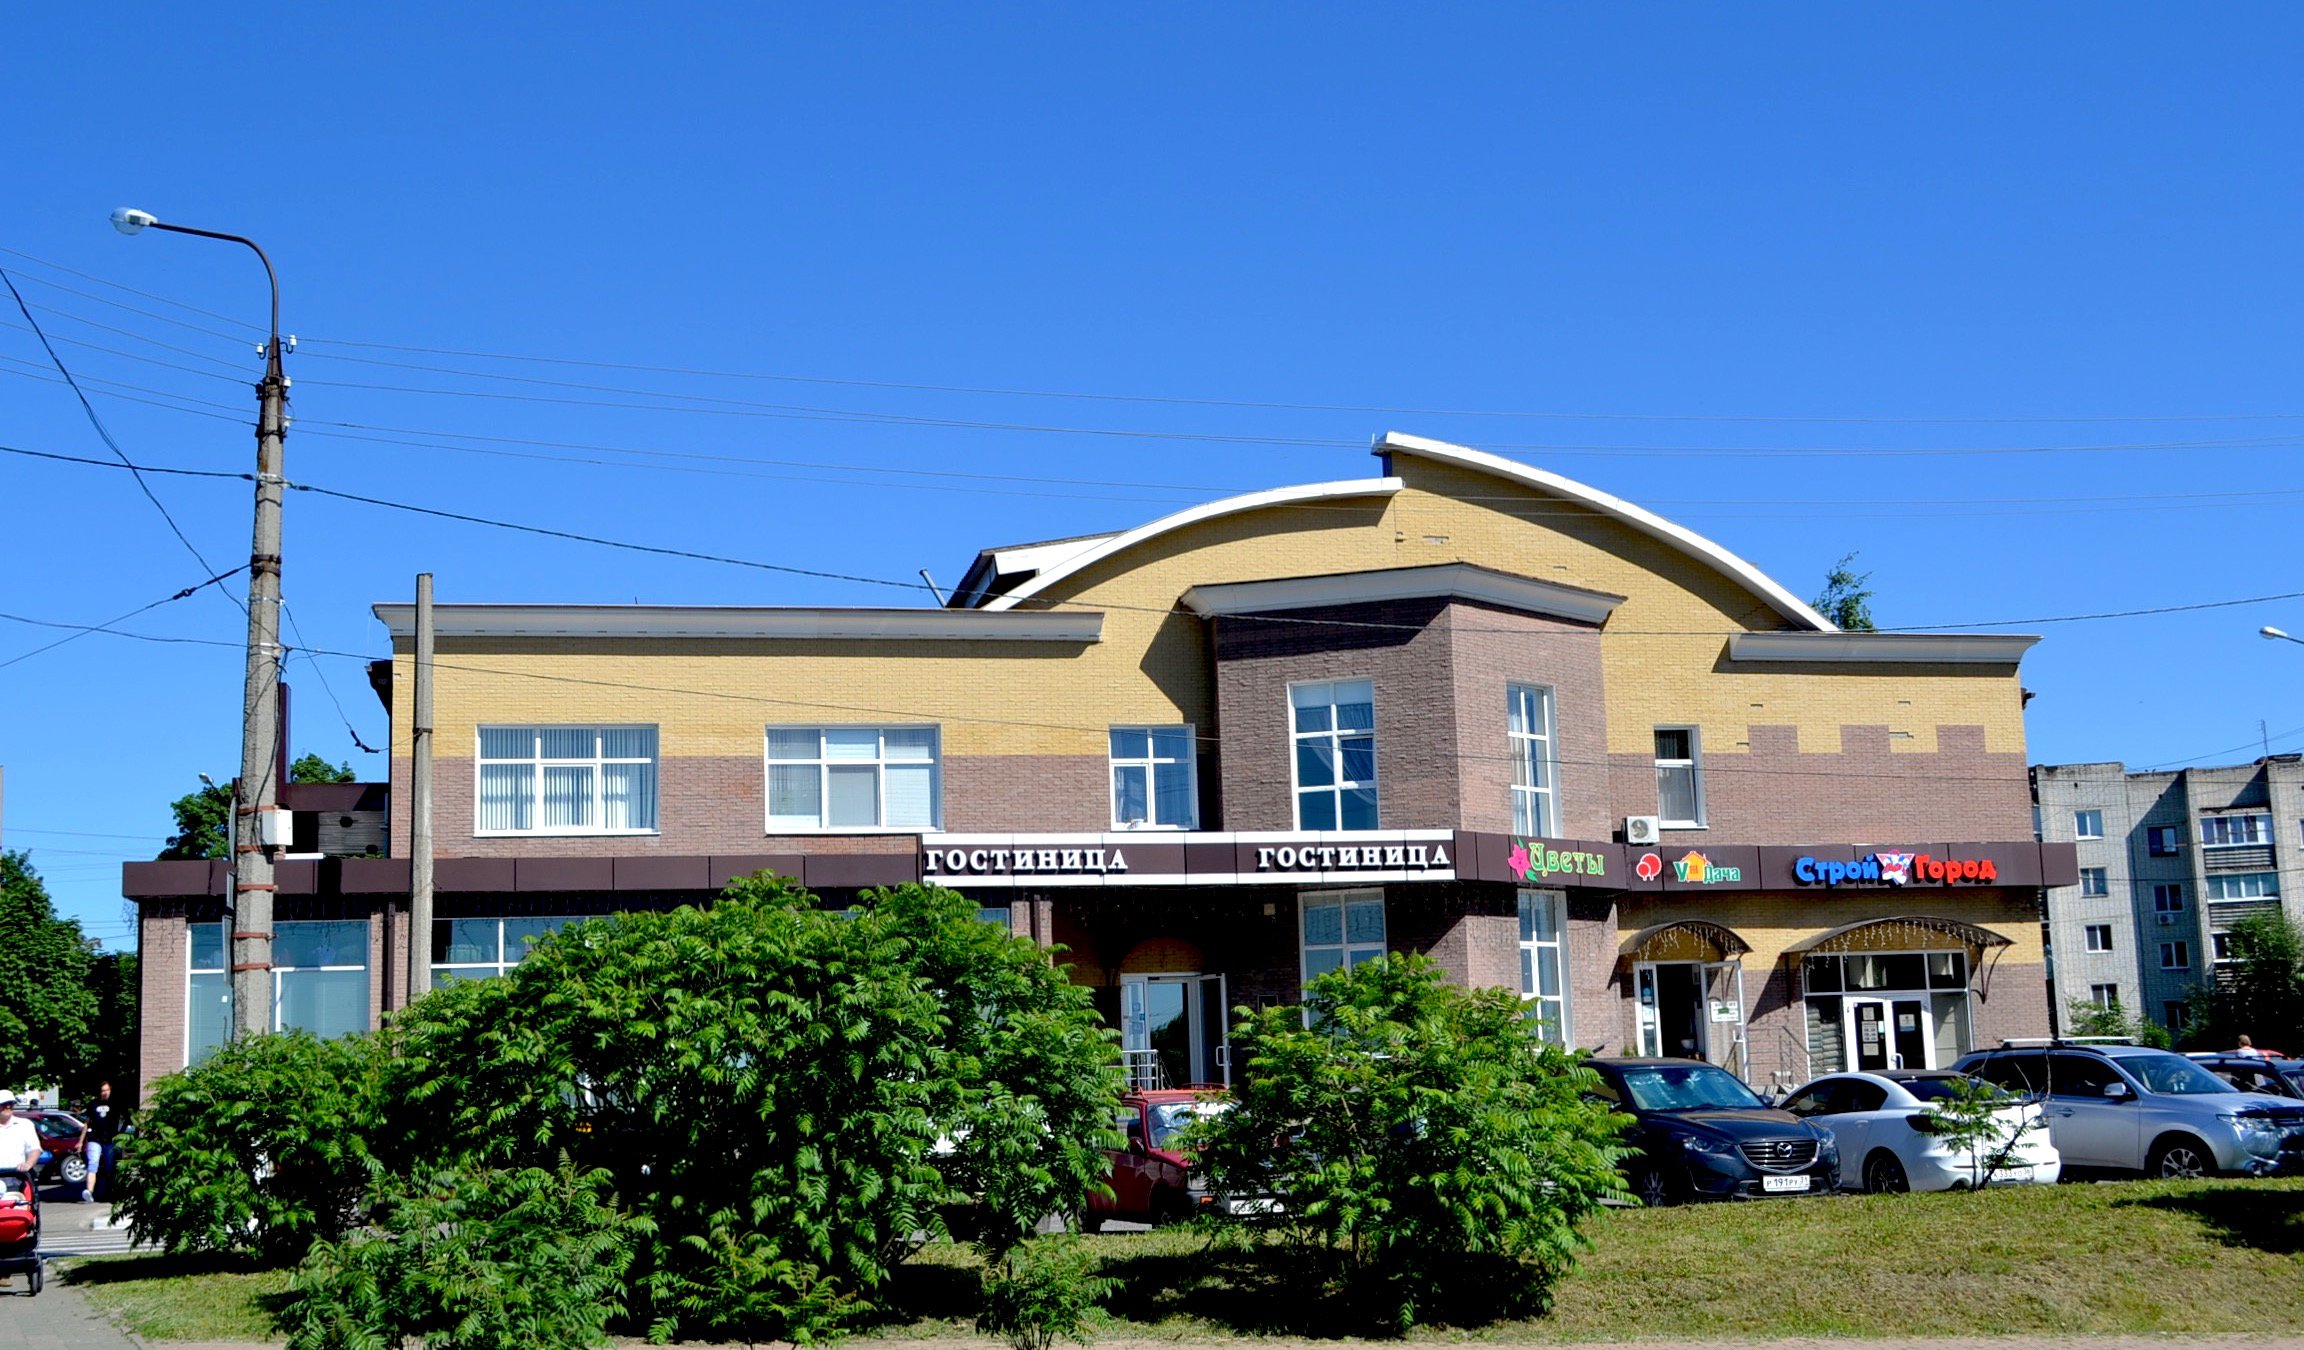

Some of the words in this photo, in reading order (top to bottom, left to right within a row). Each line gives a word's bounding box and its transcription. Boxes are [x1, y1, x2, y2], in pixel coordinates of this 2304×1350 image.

[926, 849, 1128, 872] ГОСТИНИЦА
[1258, 845, 1450, 868] ГОСТИНИЦА
[1529, 842, 1605, 877] Цветы
[1796, 855, 1879, 884] Строй
[1915, 854, 1997, 884] Город
